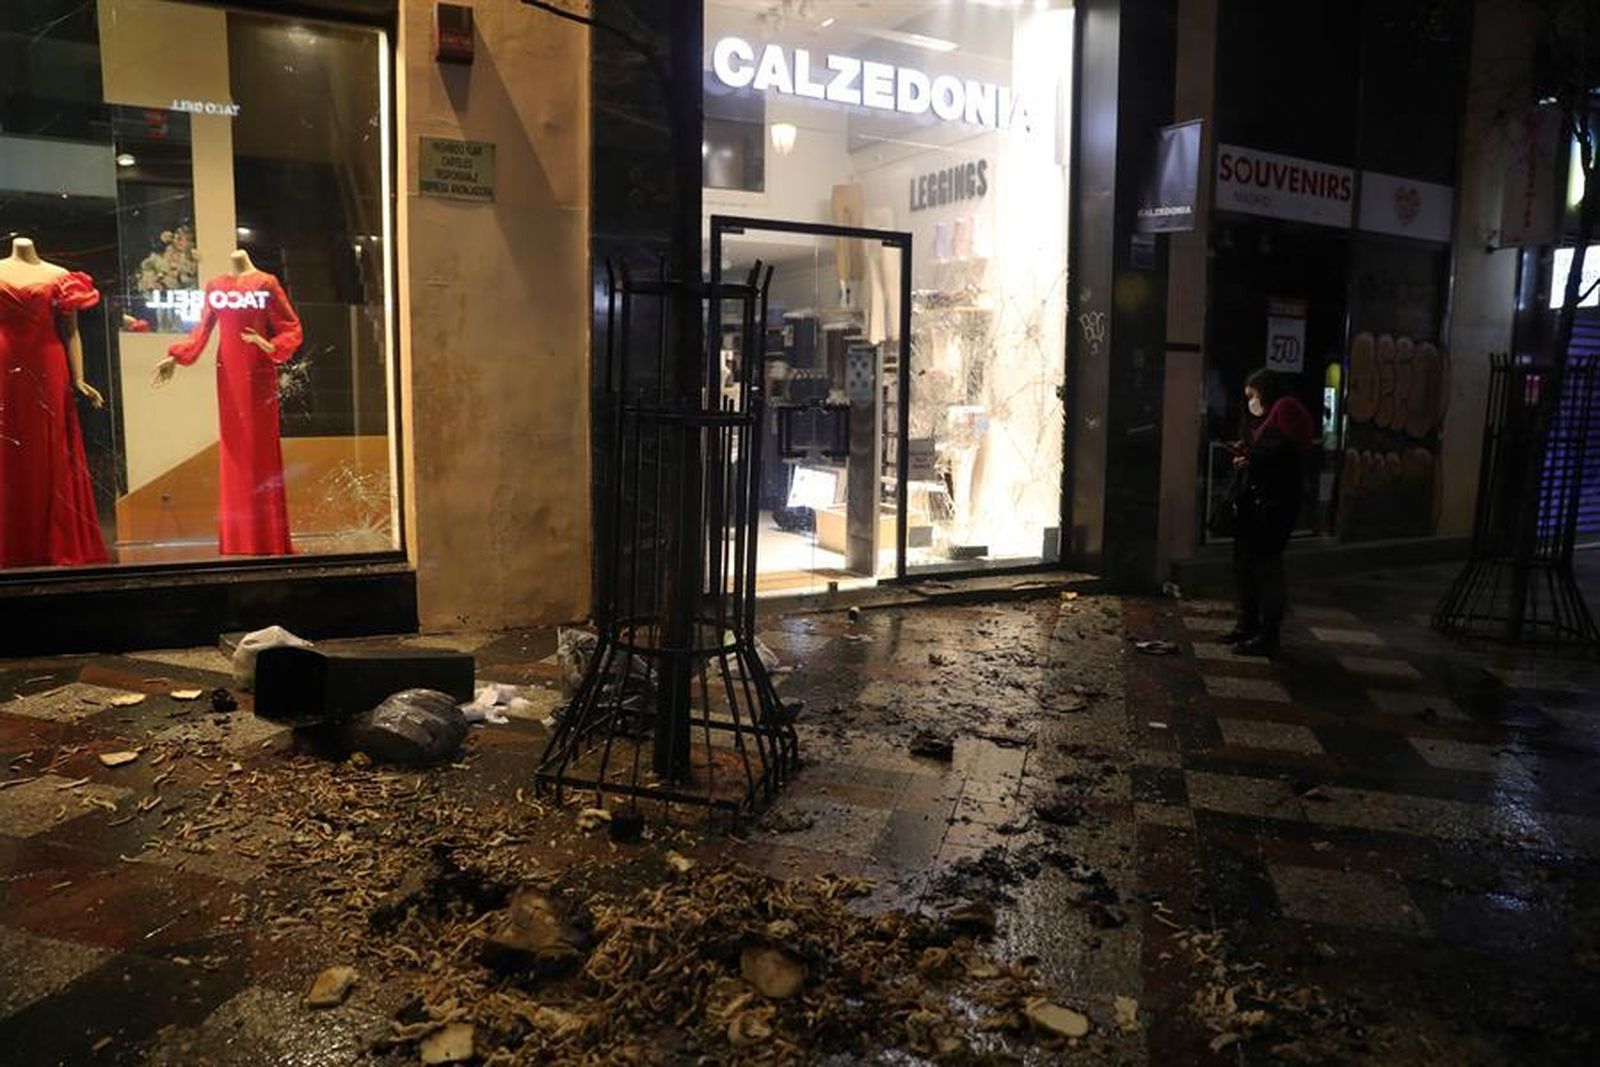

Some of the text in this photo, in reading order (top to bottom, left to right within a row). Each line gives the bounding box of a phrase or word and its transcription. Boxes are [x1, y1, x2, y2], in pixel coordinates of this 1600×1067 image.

[713, 37, 1036, 132] CALZEDONIA
[909, 159, 988, 212] LEGGINGS
[1219, 153, 1352, 202] SOUVENIRS
